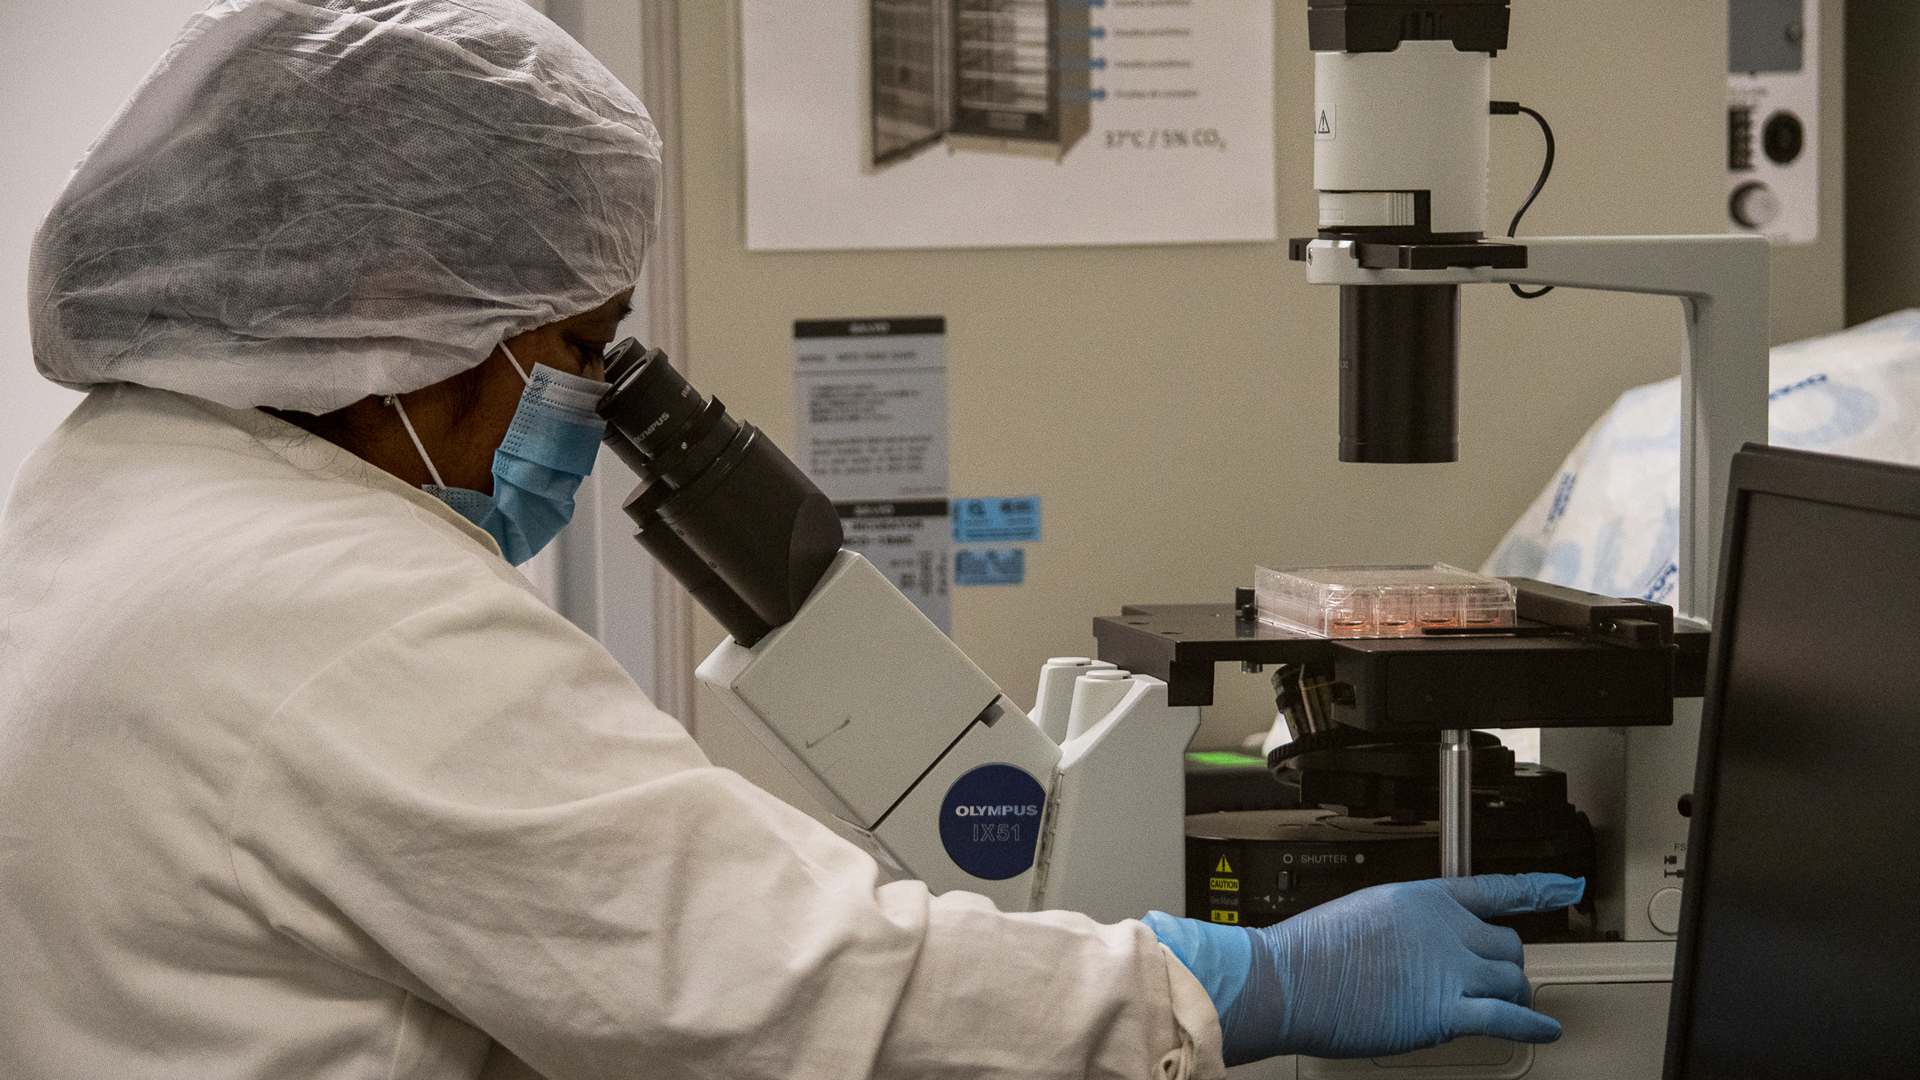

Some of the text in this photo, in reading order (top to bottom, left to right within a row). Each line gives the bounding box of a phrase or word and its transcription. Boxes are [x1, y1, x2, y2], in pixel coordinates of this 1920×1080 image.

[633, 411, 670, 444] OLYMPUS
[955, 804, 1039, 817] OLYMPUS
[972, 823, 1021, 842] IX51
[1300, 853, 1348, 864] SHUTTER
[1210, 878, 1239, 890] CAUTION
